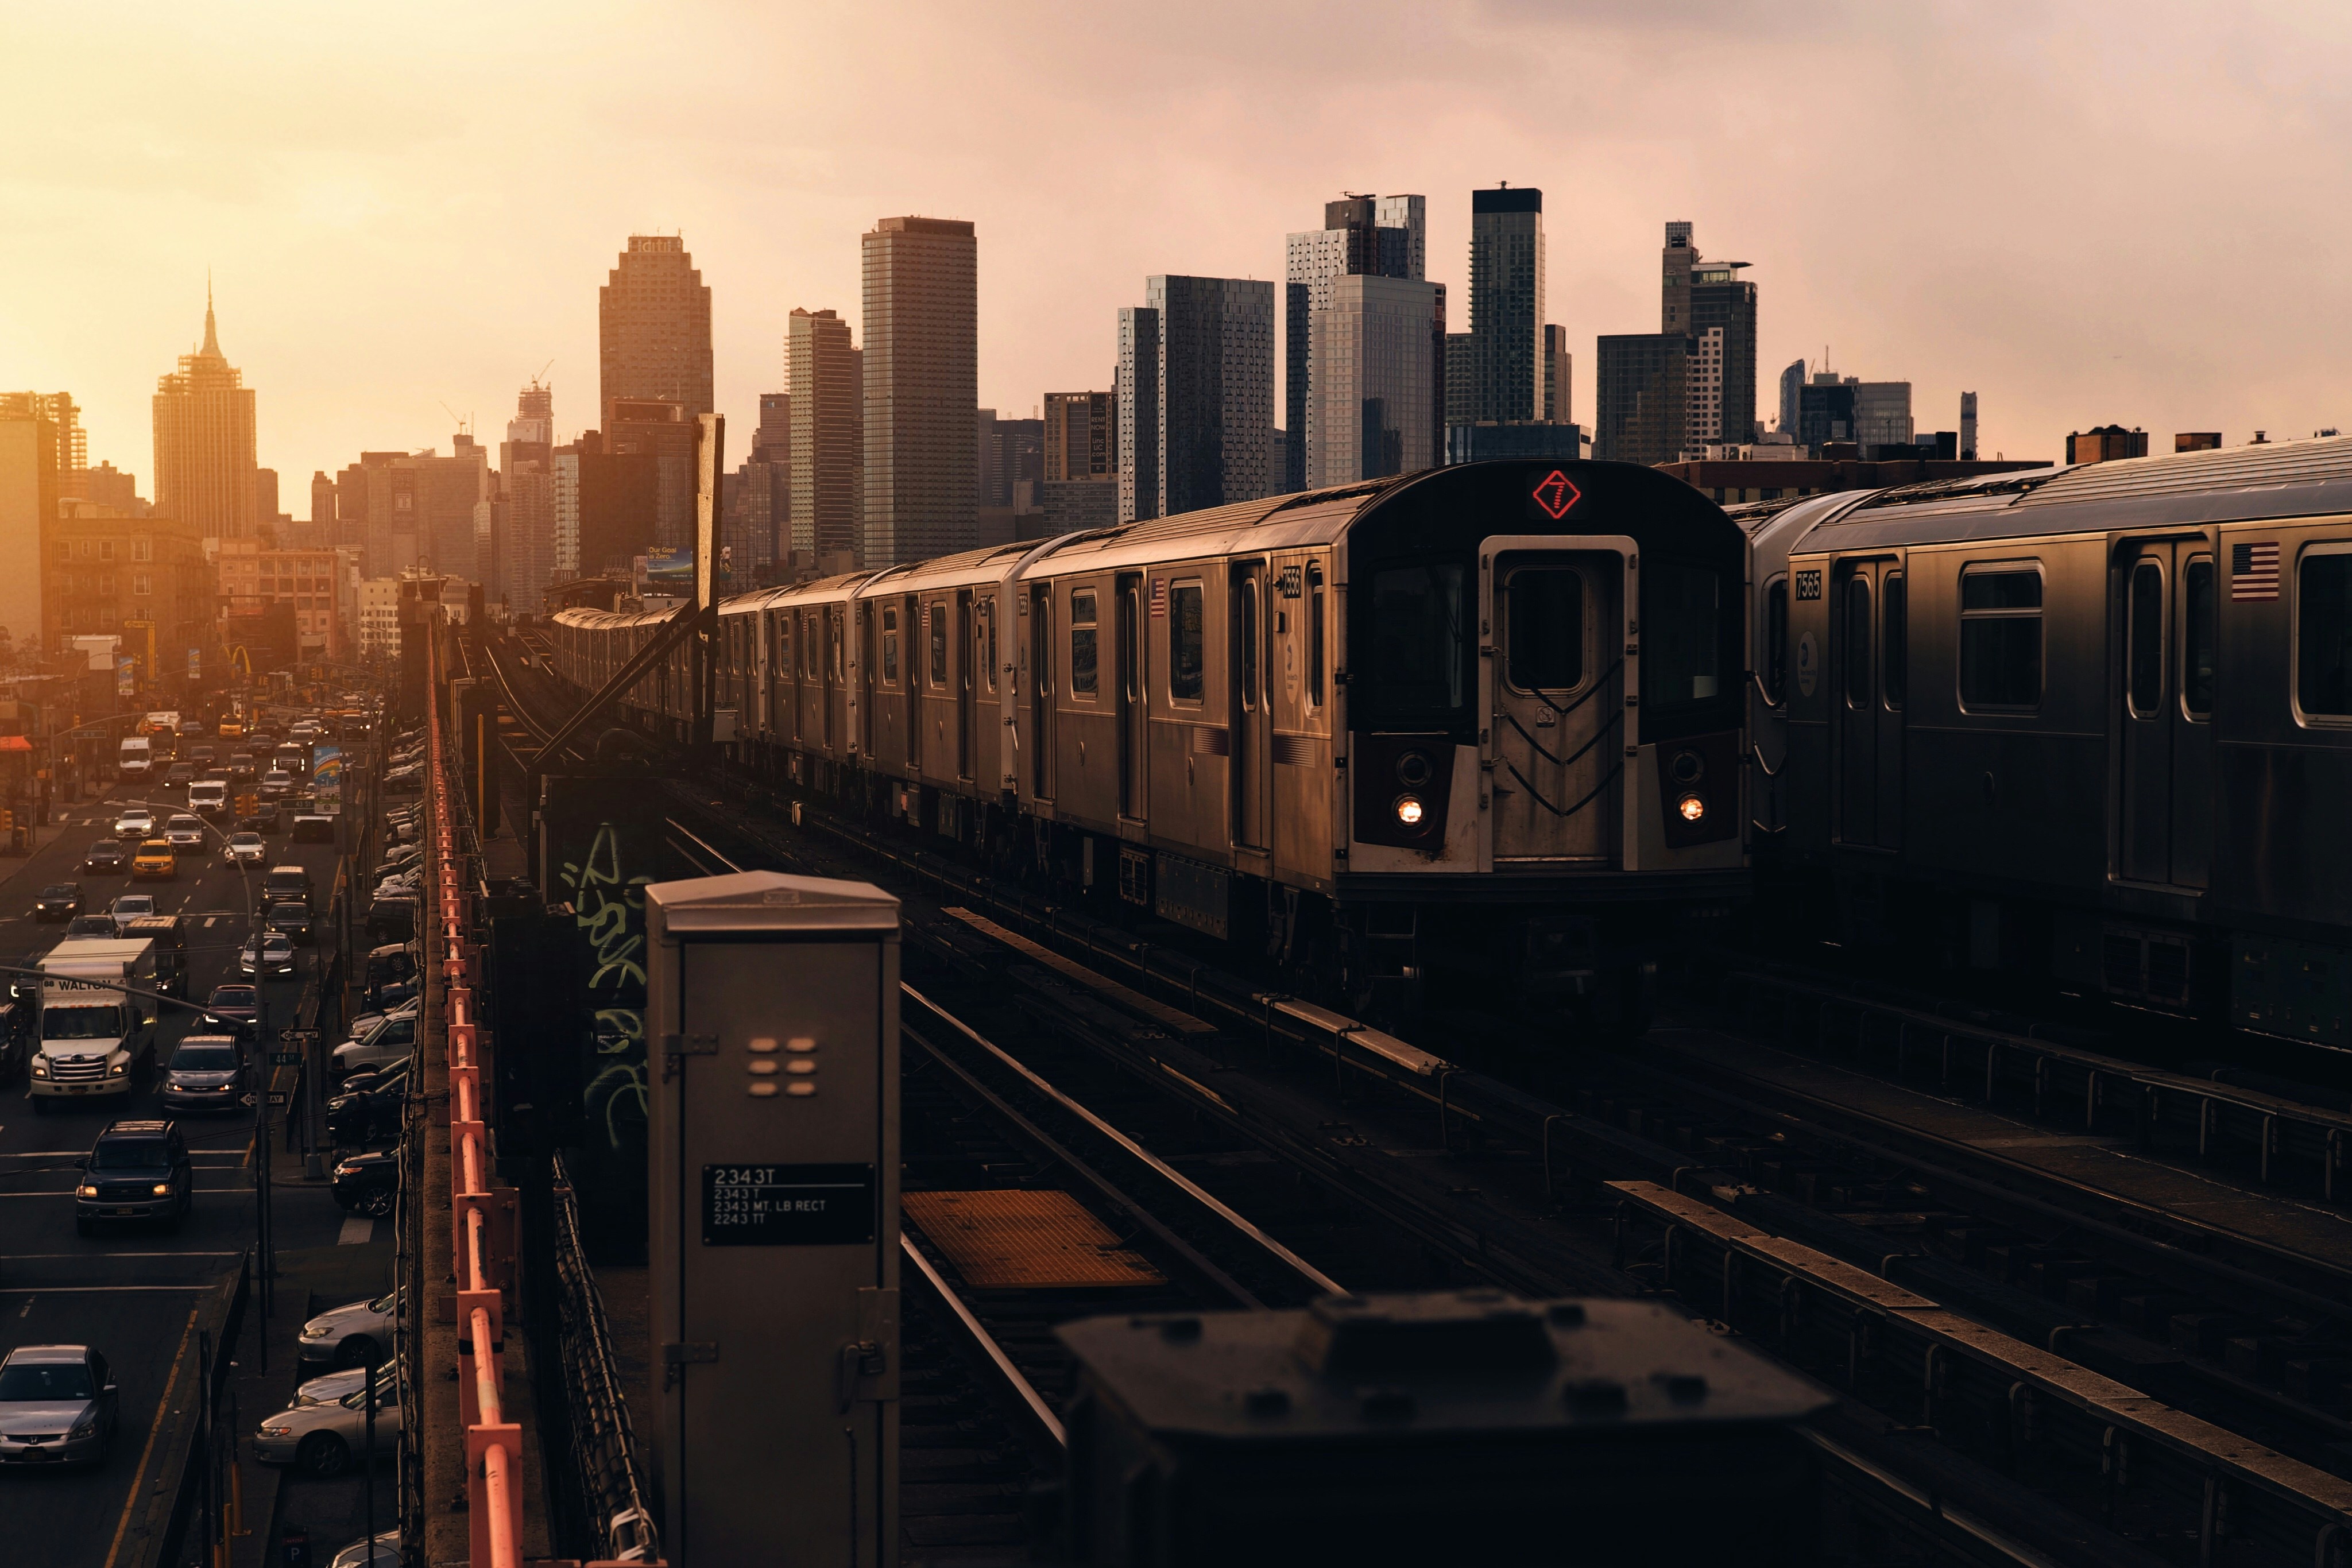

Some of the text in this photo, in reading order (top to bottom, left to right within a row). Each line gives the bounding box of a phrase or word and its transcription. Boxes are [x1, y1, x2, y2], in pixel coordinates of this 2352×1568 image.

[1548, 481, 1566, 509] 7
[1284, 568, 1300, 595] 7556
[1797, 572, 1820, 598] 7565
[276, 1054, 286, 1063] 44
[714, 1168, 776, 1184] 2343T
[714, 1188, 761, 1199] 2343 T
[714, 1200, 826, 1212] 2343 MT. LB RECT
[714, 1213, 765, 1225] 2243 TT
[291, 1547, 300, 1561] P
